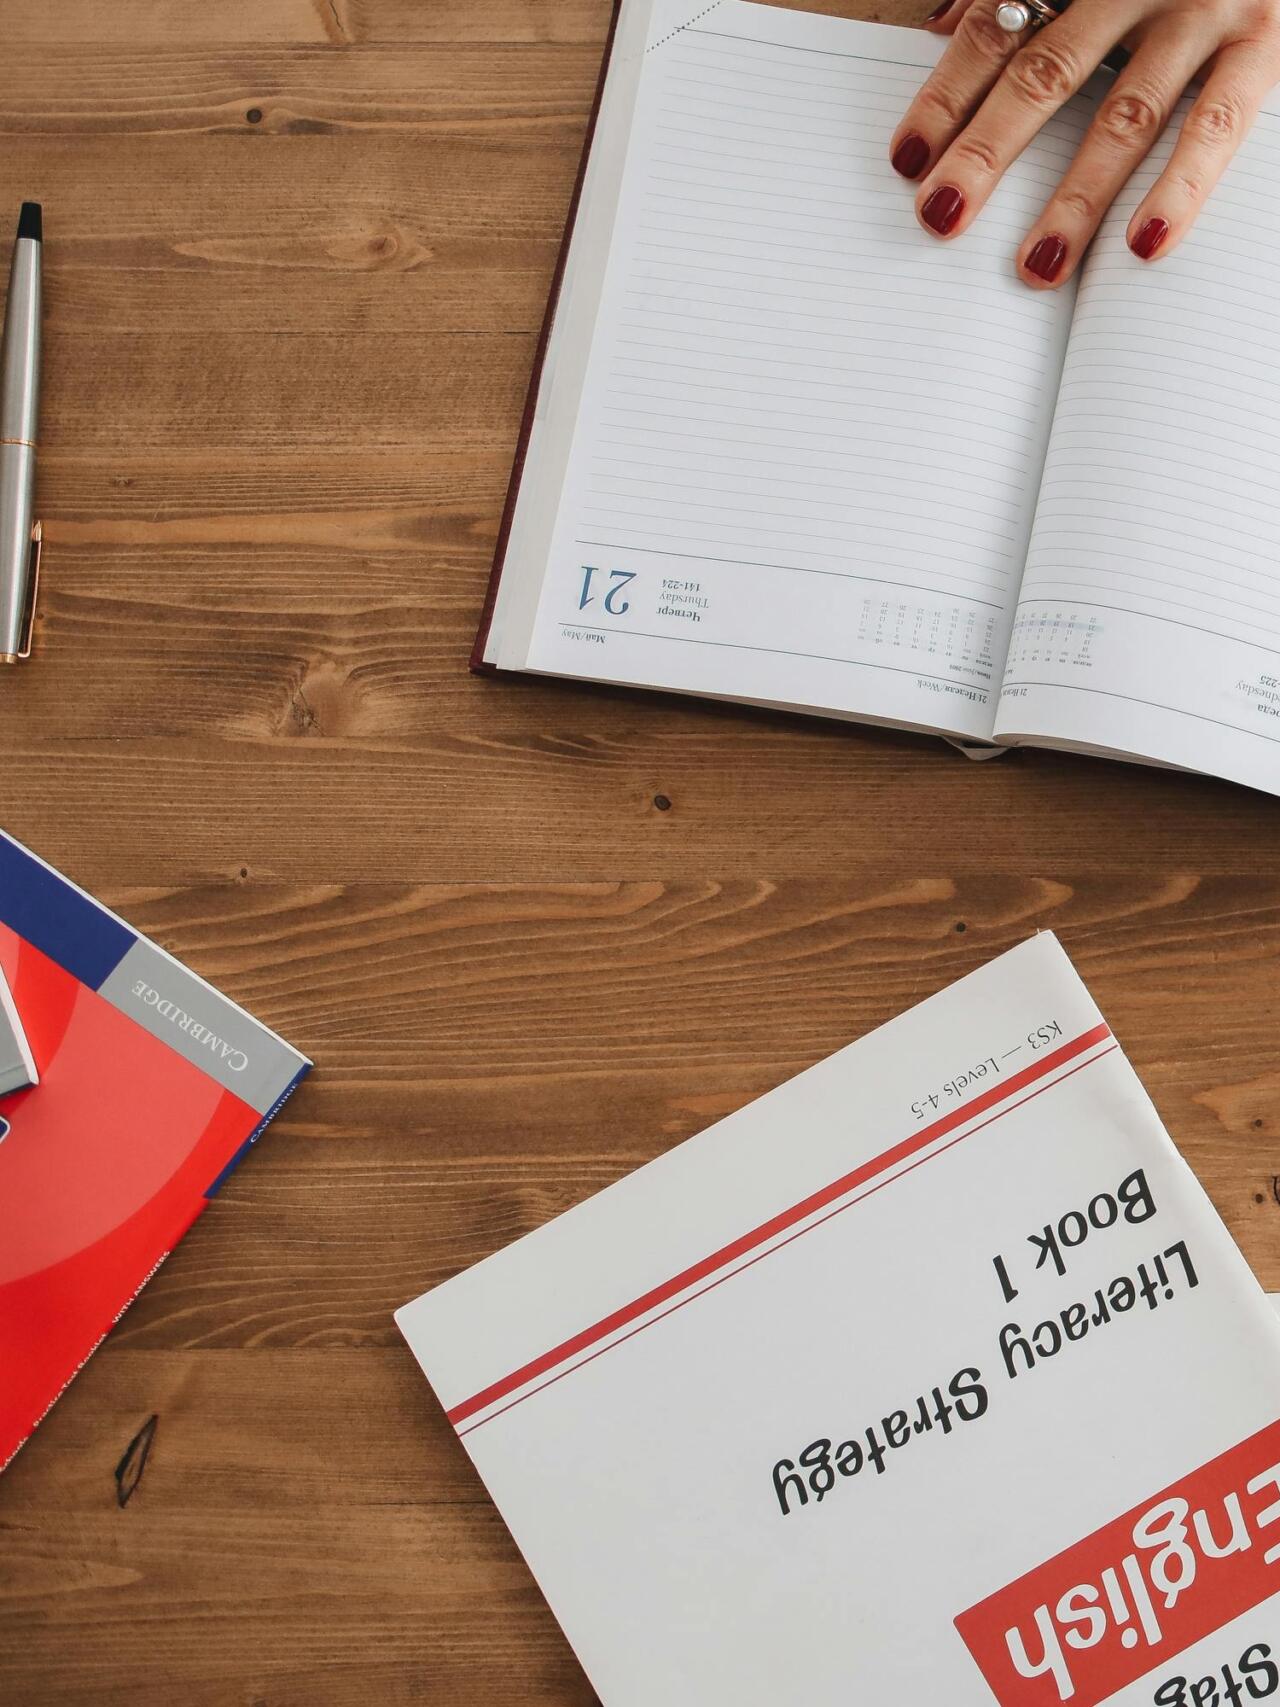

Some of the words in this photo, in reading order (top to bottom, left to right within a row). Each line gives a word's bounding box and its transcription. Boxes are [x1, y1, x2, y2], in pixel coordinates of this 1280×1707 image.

[579, 566, 637, 615] 21
[659, 592, 709, 609] Thursday
[662, 578, 701, 592] 141-224
[656, 606, 701, 622] Четверг
[561, 629, 606, 644] Май/May
[979, 694, 987, 704] 21
[1027, 1020, 1062, 1050] KS3
[943, 1057, 1000, 1097] Levels
[910, 1093, 939, 1120] 4-5
[1027, 1168, 1157, 1276] Book
[112, 1298, 135, 1324] WITH
[134, 1251, 170, 1297] ANSWERS
[992, 1255, 1019, 1304] 1
[999, 1240, 1199, 1379] Literacy
[772, 1367, 989, 1516] Strategy
